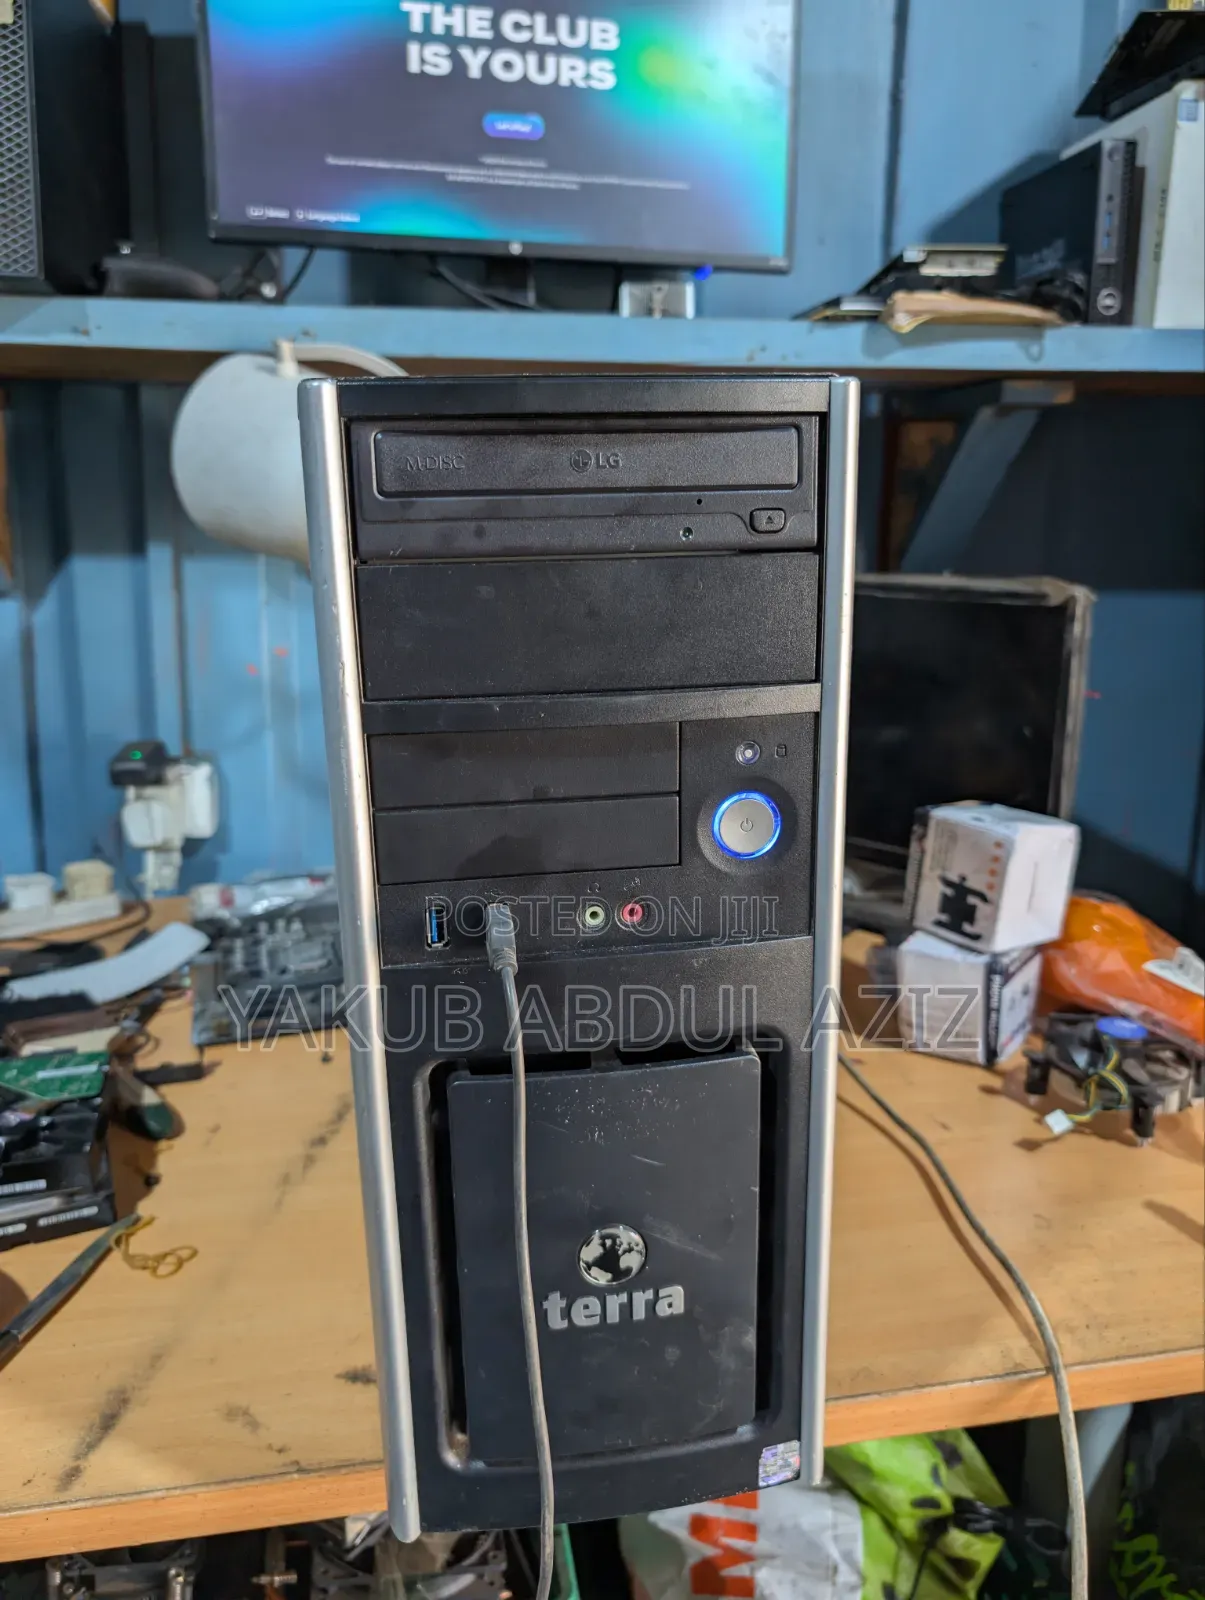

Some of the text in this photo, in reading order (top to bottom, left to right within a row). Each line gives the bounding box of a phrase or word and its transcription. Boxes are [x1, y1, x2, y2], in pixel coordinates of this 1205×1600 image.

[400, 1, 621, 51] THE CLUB
[406, 40, 617, 90] IS YOURS
[596, 452, 622, 470] LG
[542, 1284, 686, 1331] terra
